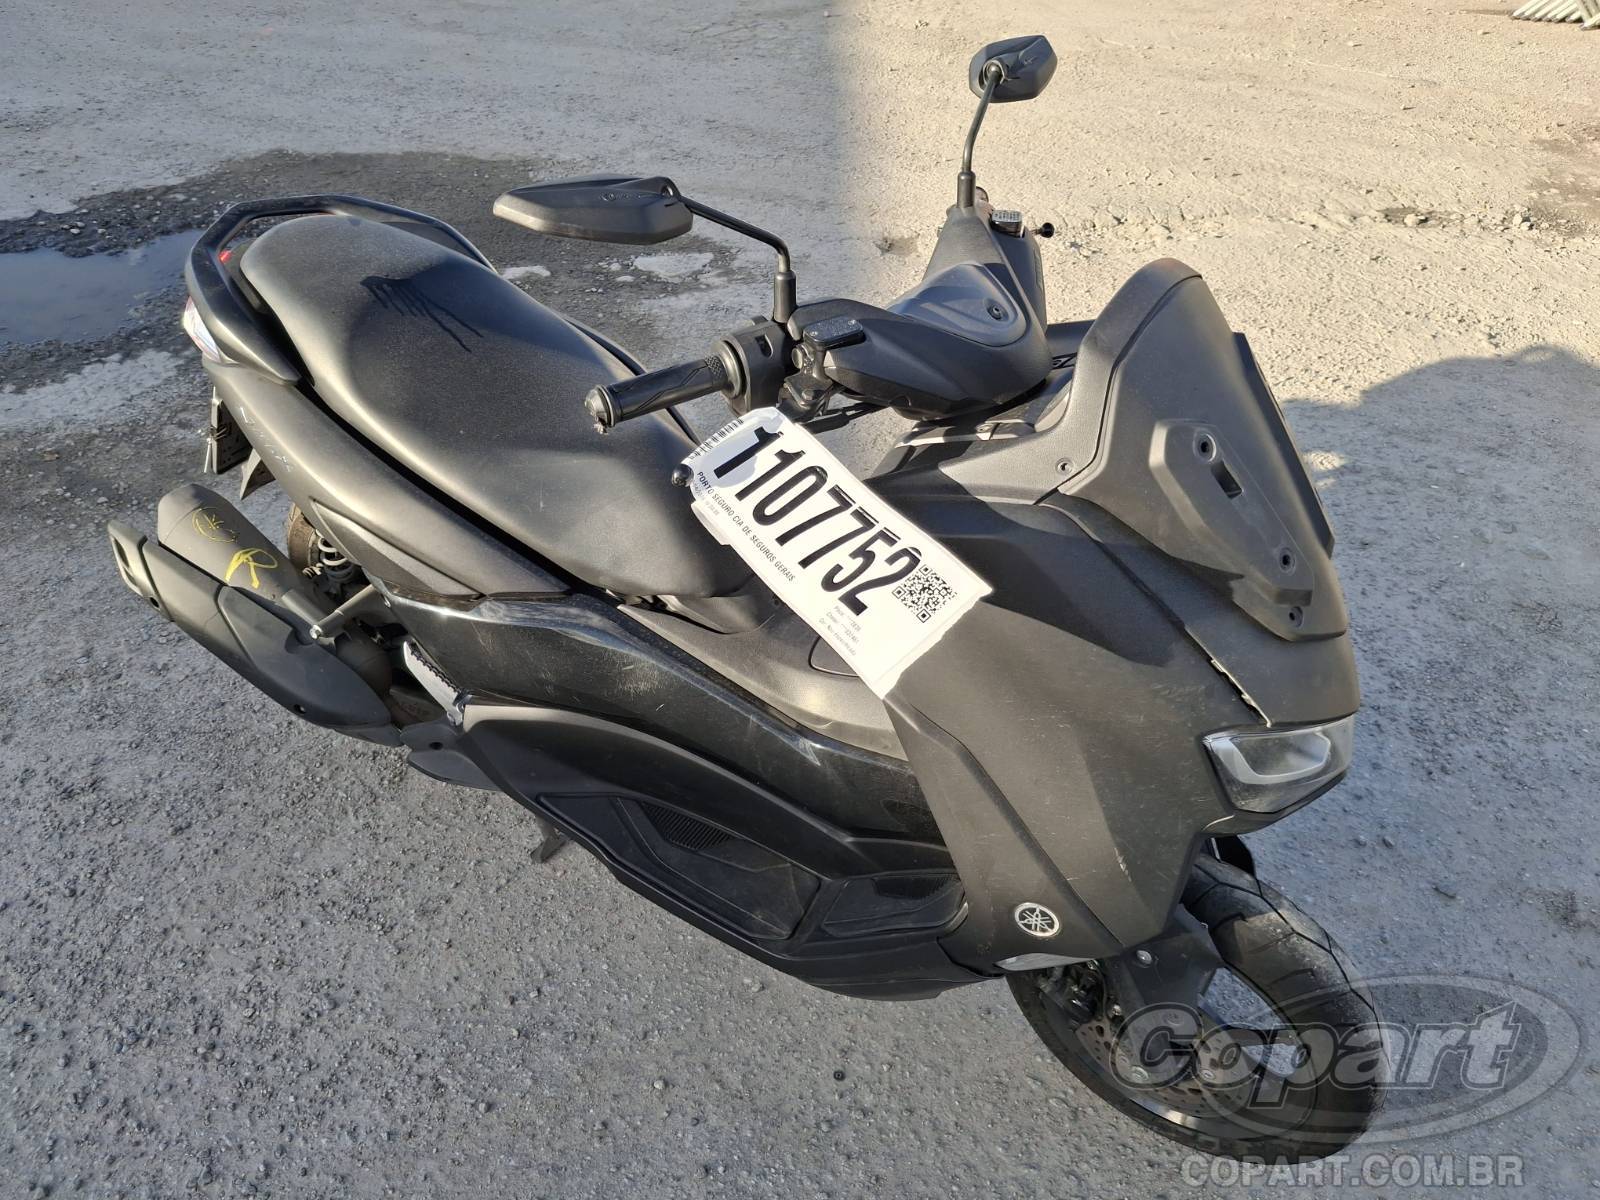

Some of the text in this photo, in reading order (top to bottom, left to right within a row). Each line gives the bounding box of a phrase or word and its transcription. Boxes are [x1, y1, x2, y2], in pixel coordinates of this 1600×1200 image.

[697, 471, 714, 495] PORTO
[712, 493, 735, 517] SEGURO
[732, 515, 744, 529] CIA
[741, 524, 752, 537] DE
[750, 534, 776, 563] SEGUROS
[774, 557, 796, 582] GERAIS
[713, 426, 922, 616] 1107752
